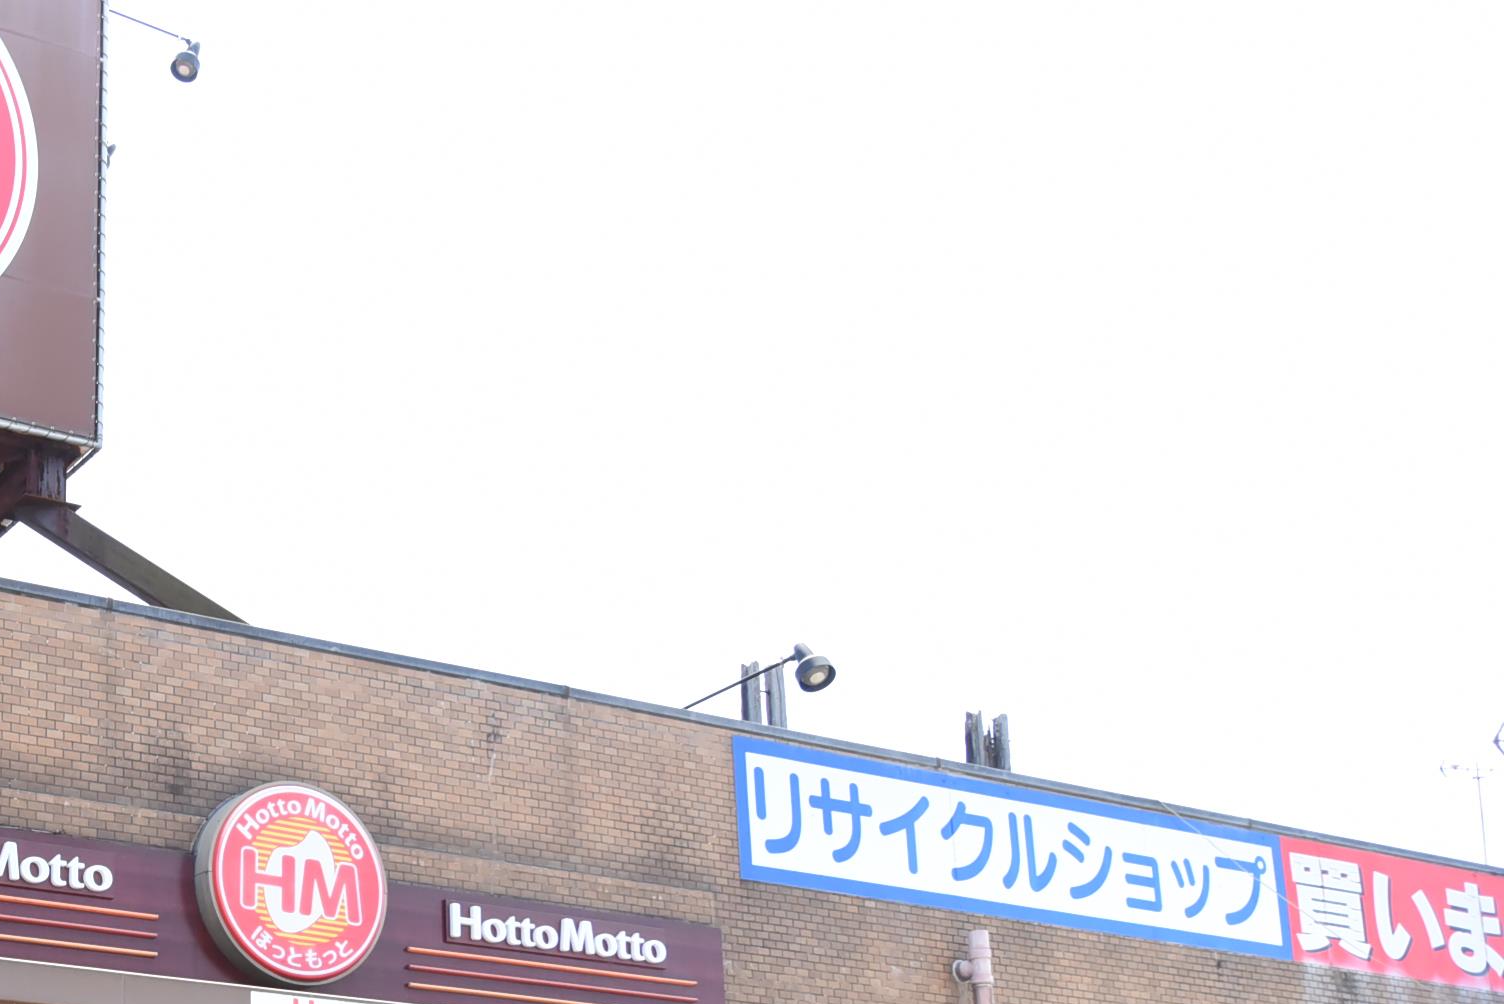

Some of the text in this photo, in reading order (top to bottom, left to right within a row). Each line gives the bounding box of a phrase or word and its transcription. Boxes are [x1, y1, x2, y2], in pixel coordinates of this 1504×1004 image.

[240, 846, 362, 926] HM
[753, 765, 1267, 927] リサイクルショップ
[251, 926, 354, 969] ほっともっと
